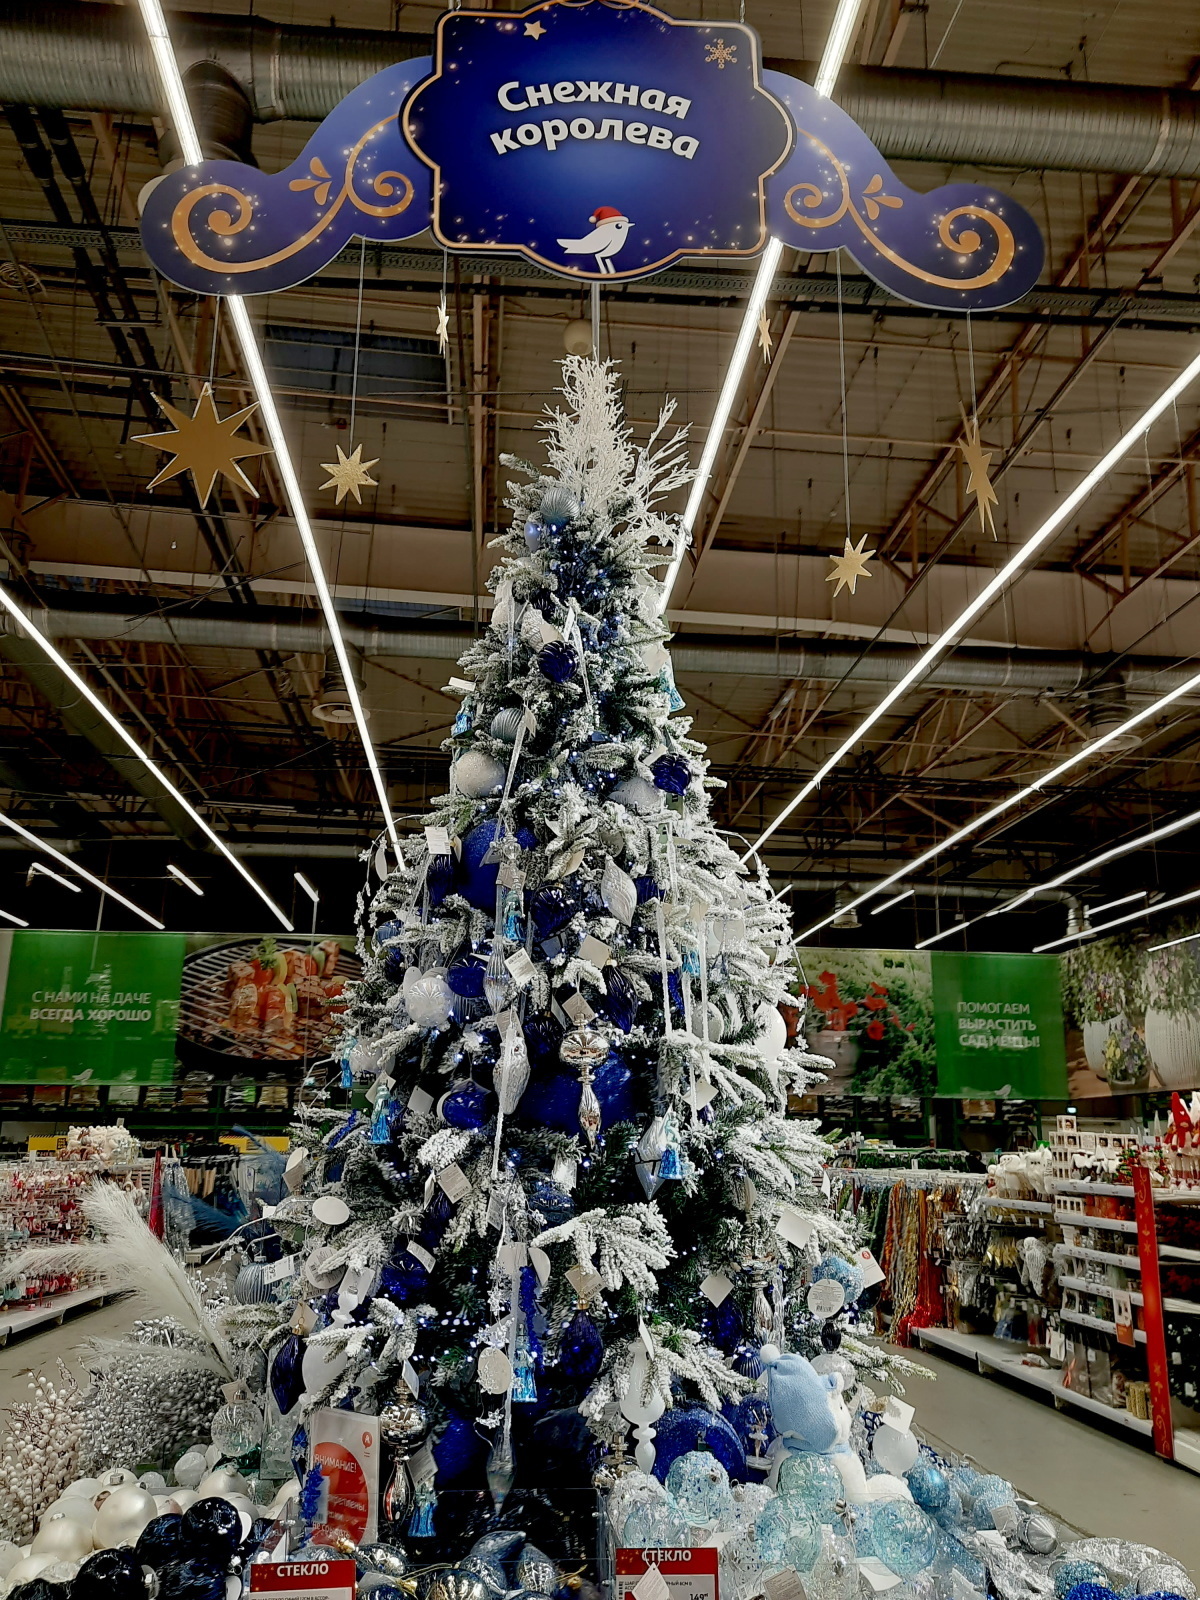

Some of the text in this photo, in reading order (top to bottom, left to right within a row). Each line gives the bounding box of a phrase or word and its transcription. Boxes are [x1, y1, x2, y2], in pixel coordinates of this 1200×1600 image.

[498, 81, 692, 119] Снежная
[490, 116, 700, 160] королева
[32, 991, 42, 1003] С
[44, 991, 88, 1004] НАМИ
[112, 992, 152, 1006] ДАЧЕ
[957, 1001, 1030, 1014] ПОМОГАЕМ
[29, 1008, 152, 1023] ВСЕГДА ХОРОШО
[958, 1018, 1037, 1031] ВЫРАСТИТЬ
[959, 1034, 989, 1049] САД
[314, 1453, 357, 1474] ВНИМАНИЕ!
[641, 1550, 692, 1562] СТЕКЛО
[276, 1563, 329, 1577] СТЕКЛО
